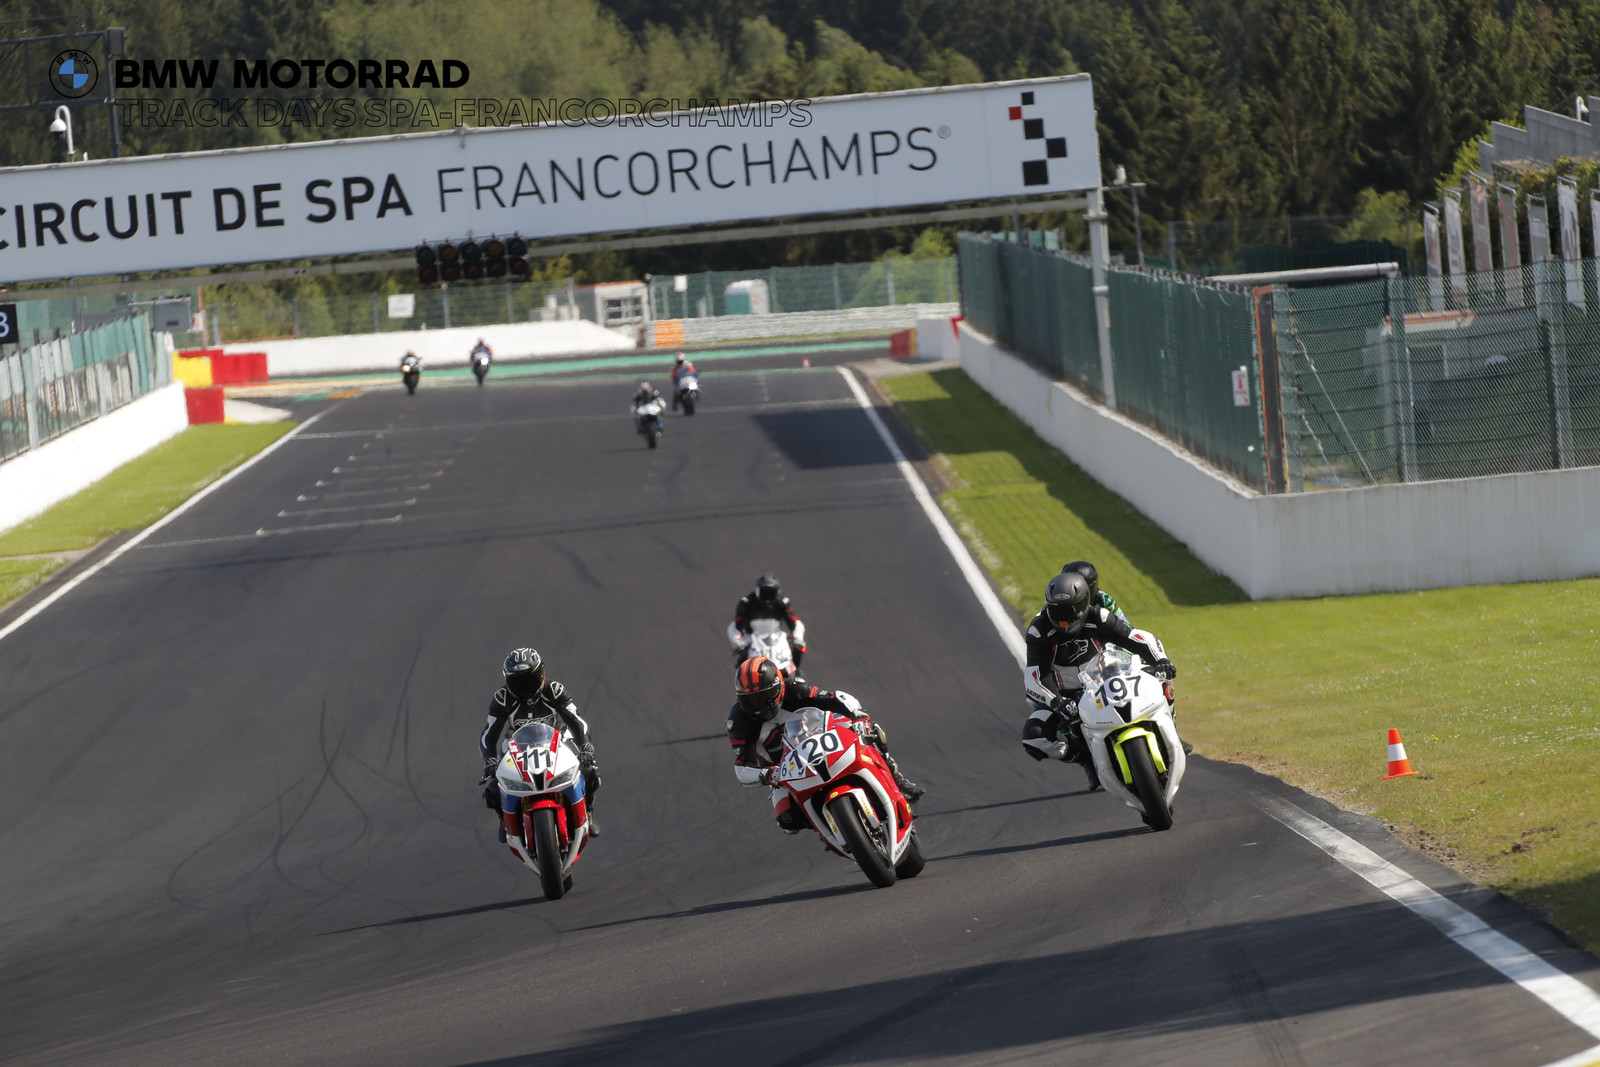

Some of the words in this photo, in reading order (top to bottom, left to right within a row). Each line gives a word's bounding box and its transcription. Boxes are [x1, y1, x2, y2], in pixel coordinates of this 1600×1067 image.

[212, 183, 285, 232] DE
[305, 174, 413, 224] SPA
[1095, 675, 1141, 707] 197
[517, 749, 551, 771] 111
[789, 732, 839, 770] 120
